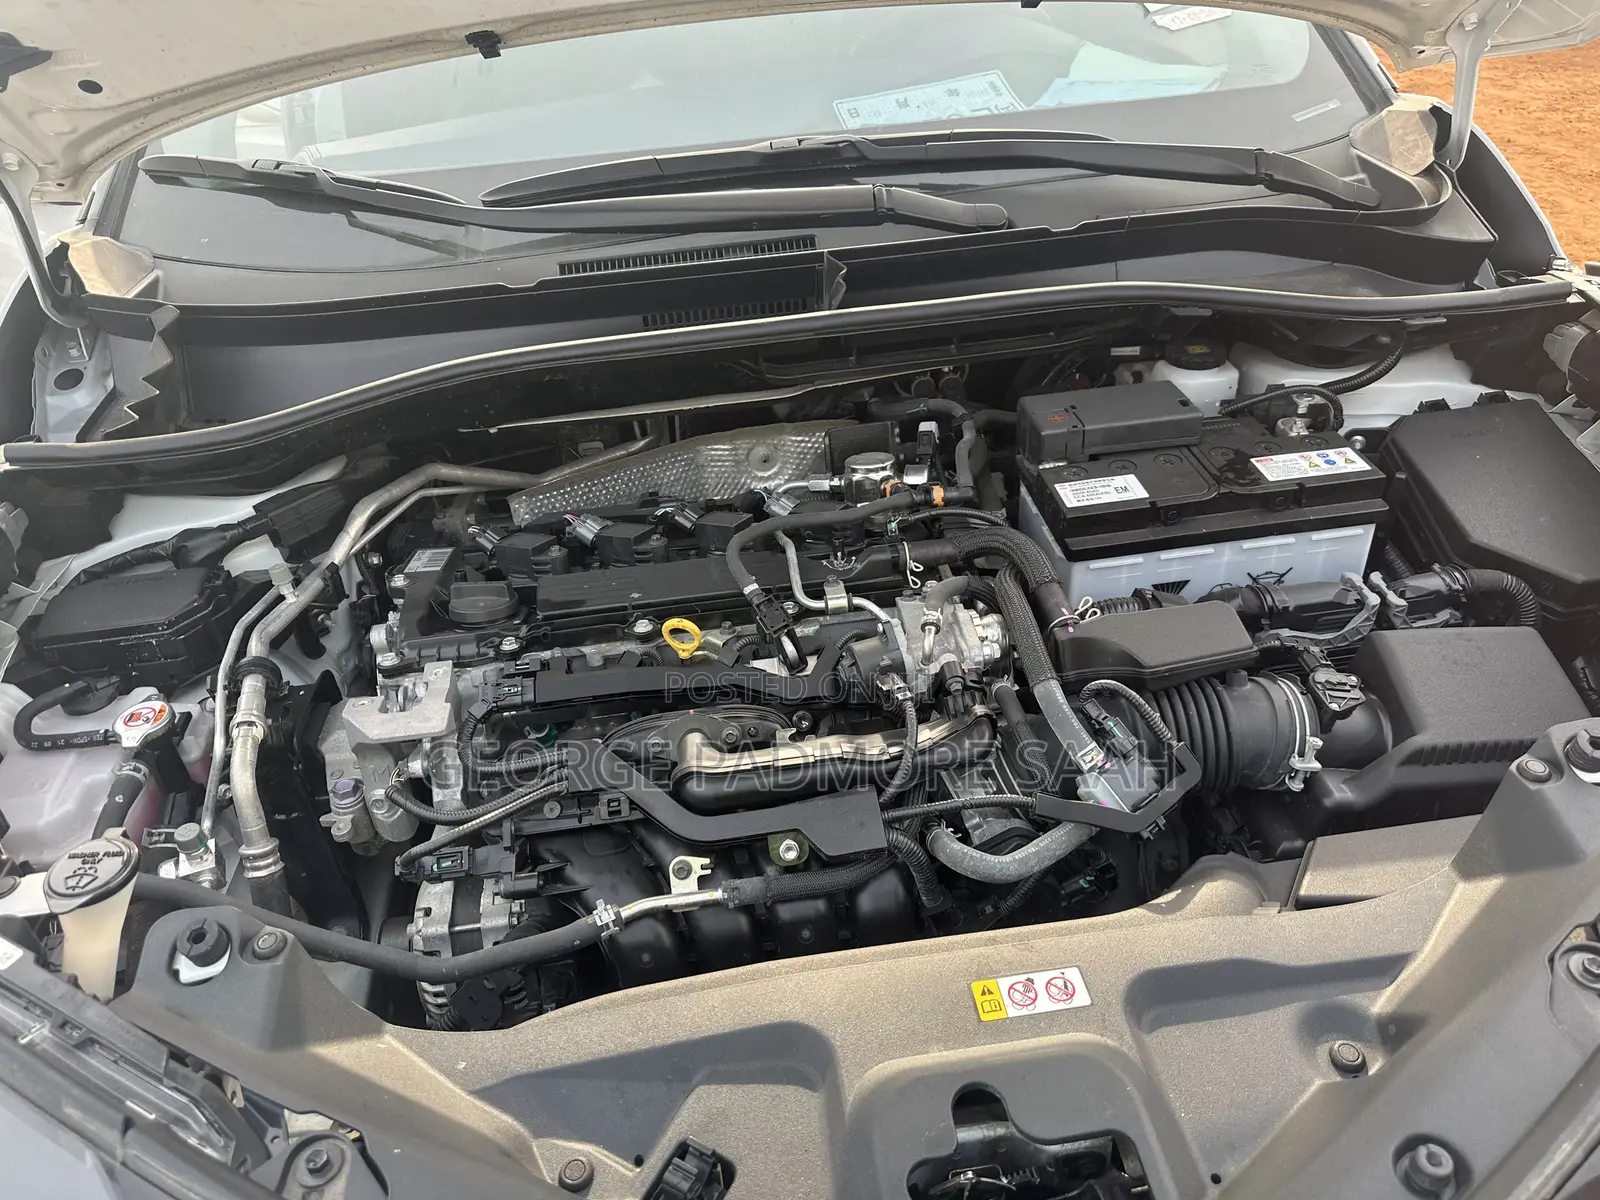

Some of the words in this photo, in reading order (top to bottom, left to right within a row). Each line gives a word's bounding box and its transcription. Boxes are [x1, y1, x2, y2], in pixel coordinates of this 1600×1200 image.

[1114, 485, 1131, 495] EM
[102, 850, 125, 858] FLUID
[81, 857, 103, 865] ONLY
